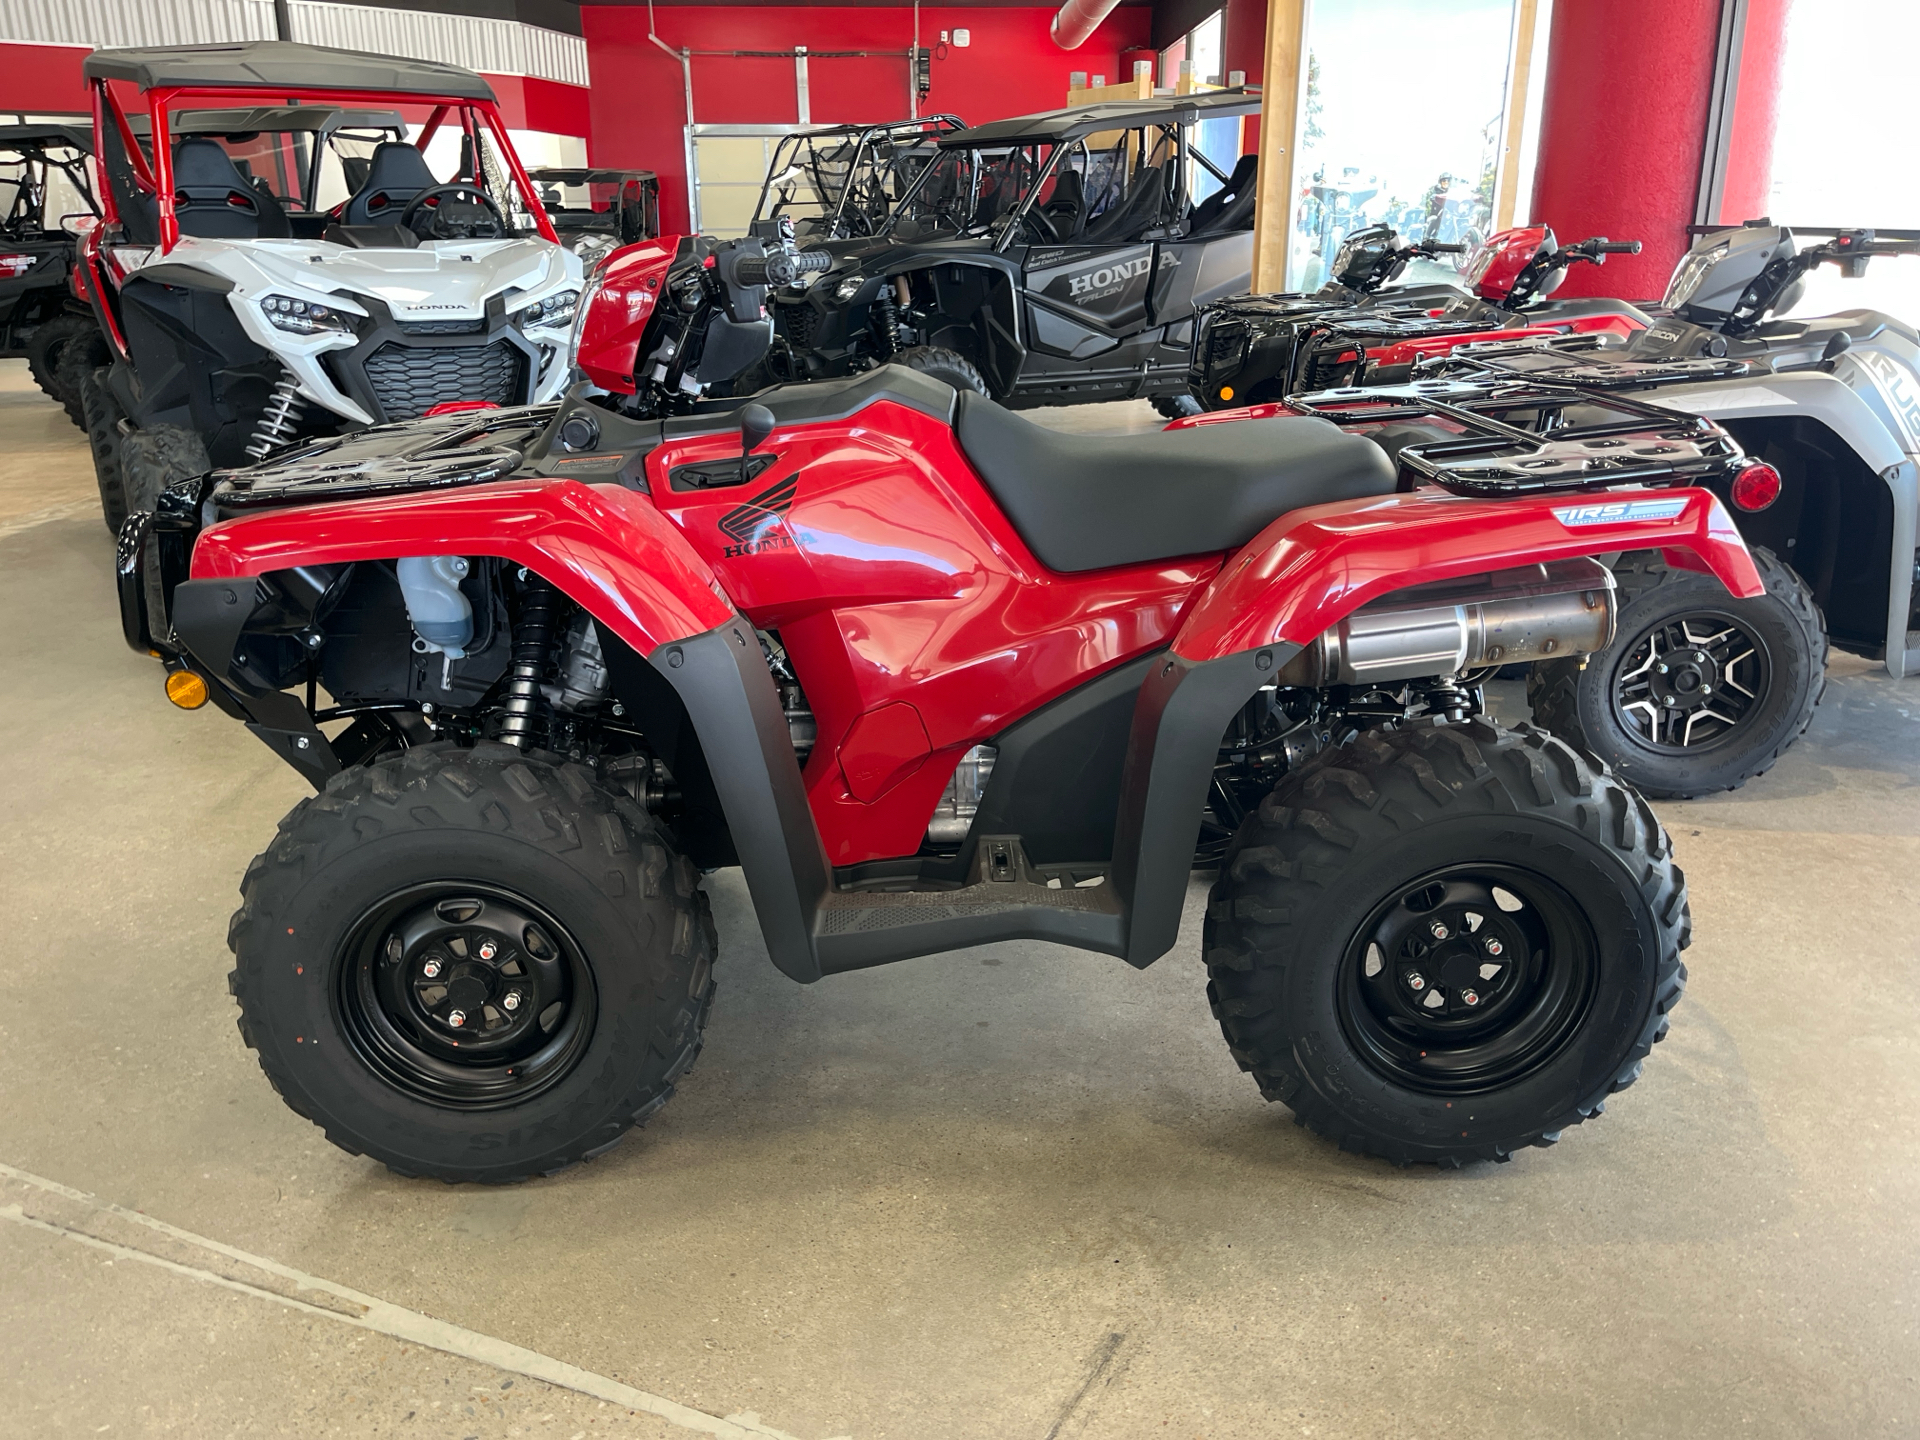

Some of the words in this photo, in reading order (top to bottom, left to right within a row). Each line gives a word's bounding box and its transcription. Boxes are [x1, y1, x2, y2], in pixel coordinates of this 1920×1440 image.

[1069, 251, 1182, 297] HONDA
[1074, 284, 1125, 306] TALON
[1567, 503, 1628, 521] IRS
[722, 531, 818, 559] HONDA
[1753, 620, 1799, 746] MAXXIS
